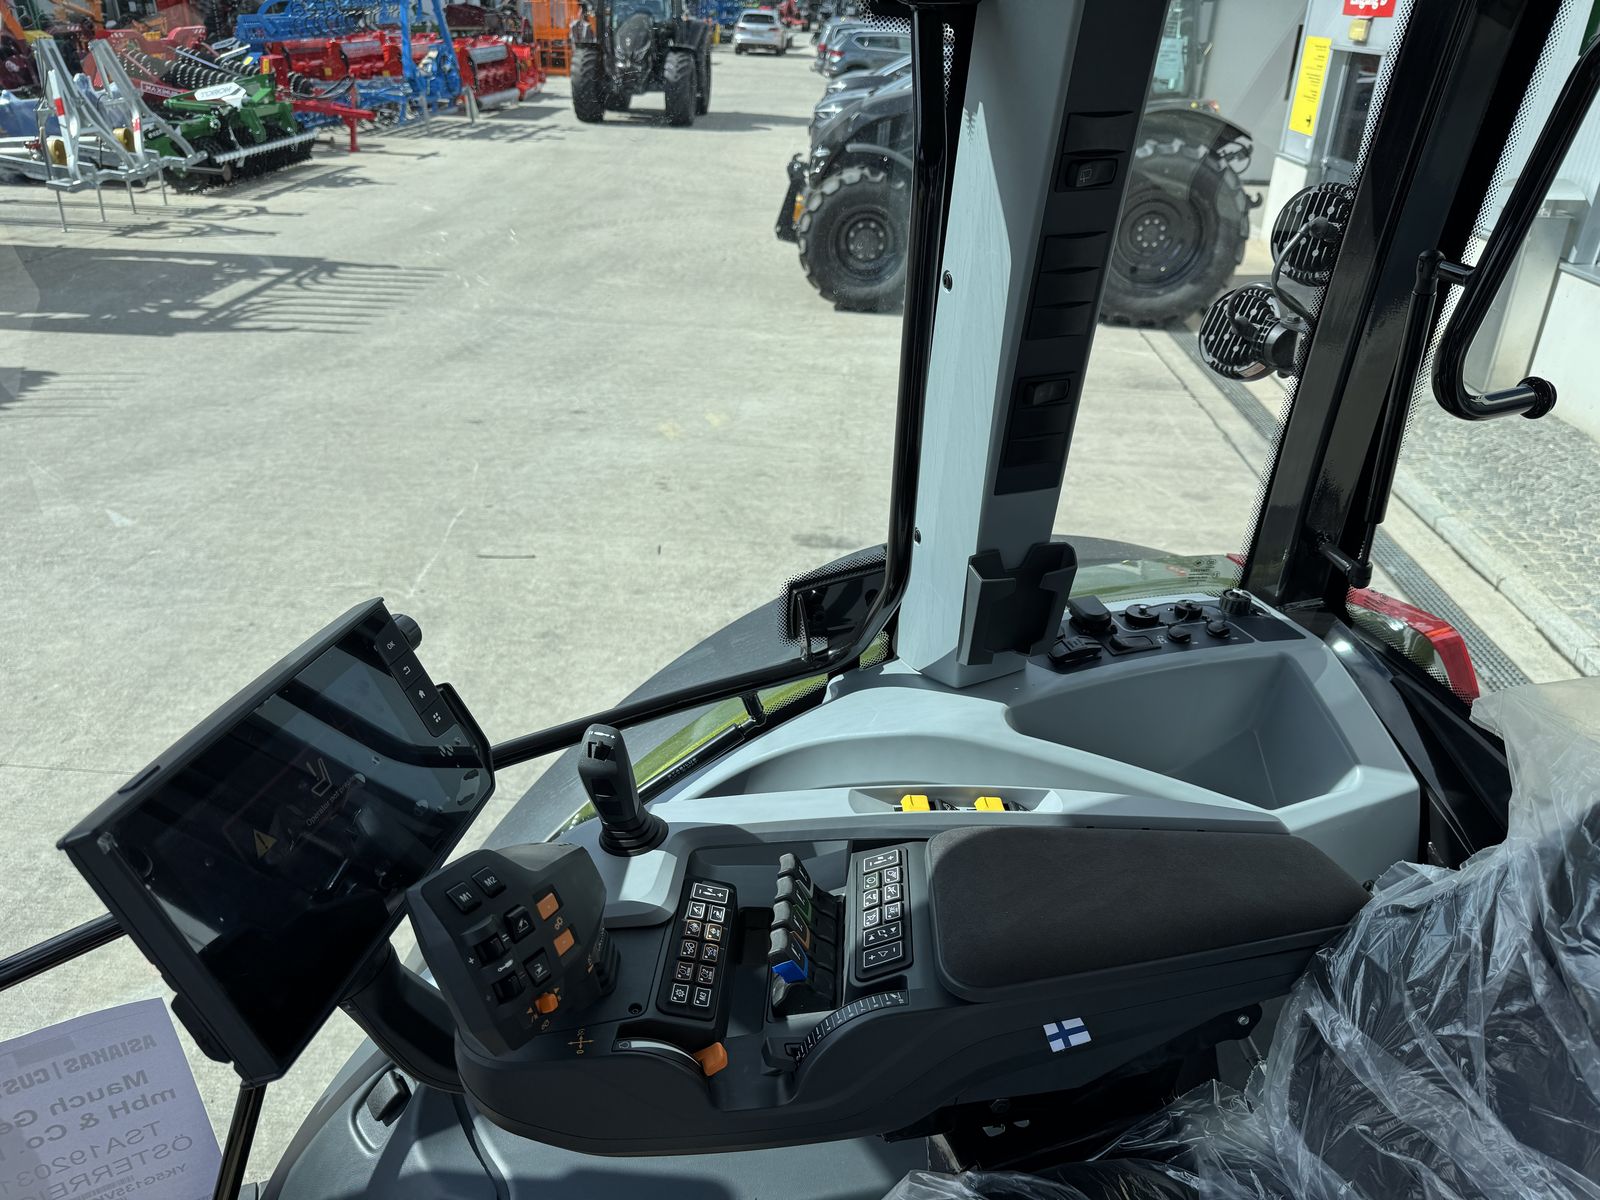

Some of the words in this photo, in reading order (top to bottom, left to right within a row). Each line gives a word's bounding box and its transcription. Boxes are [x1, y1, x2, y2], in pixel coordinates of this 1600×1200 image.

[386, 640, 396, 650] OK
[484, 875, 498, 887] M2
[459, 891, 473, 902] M1
